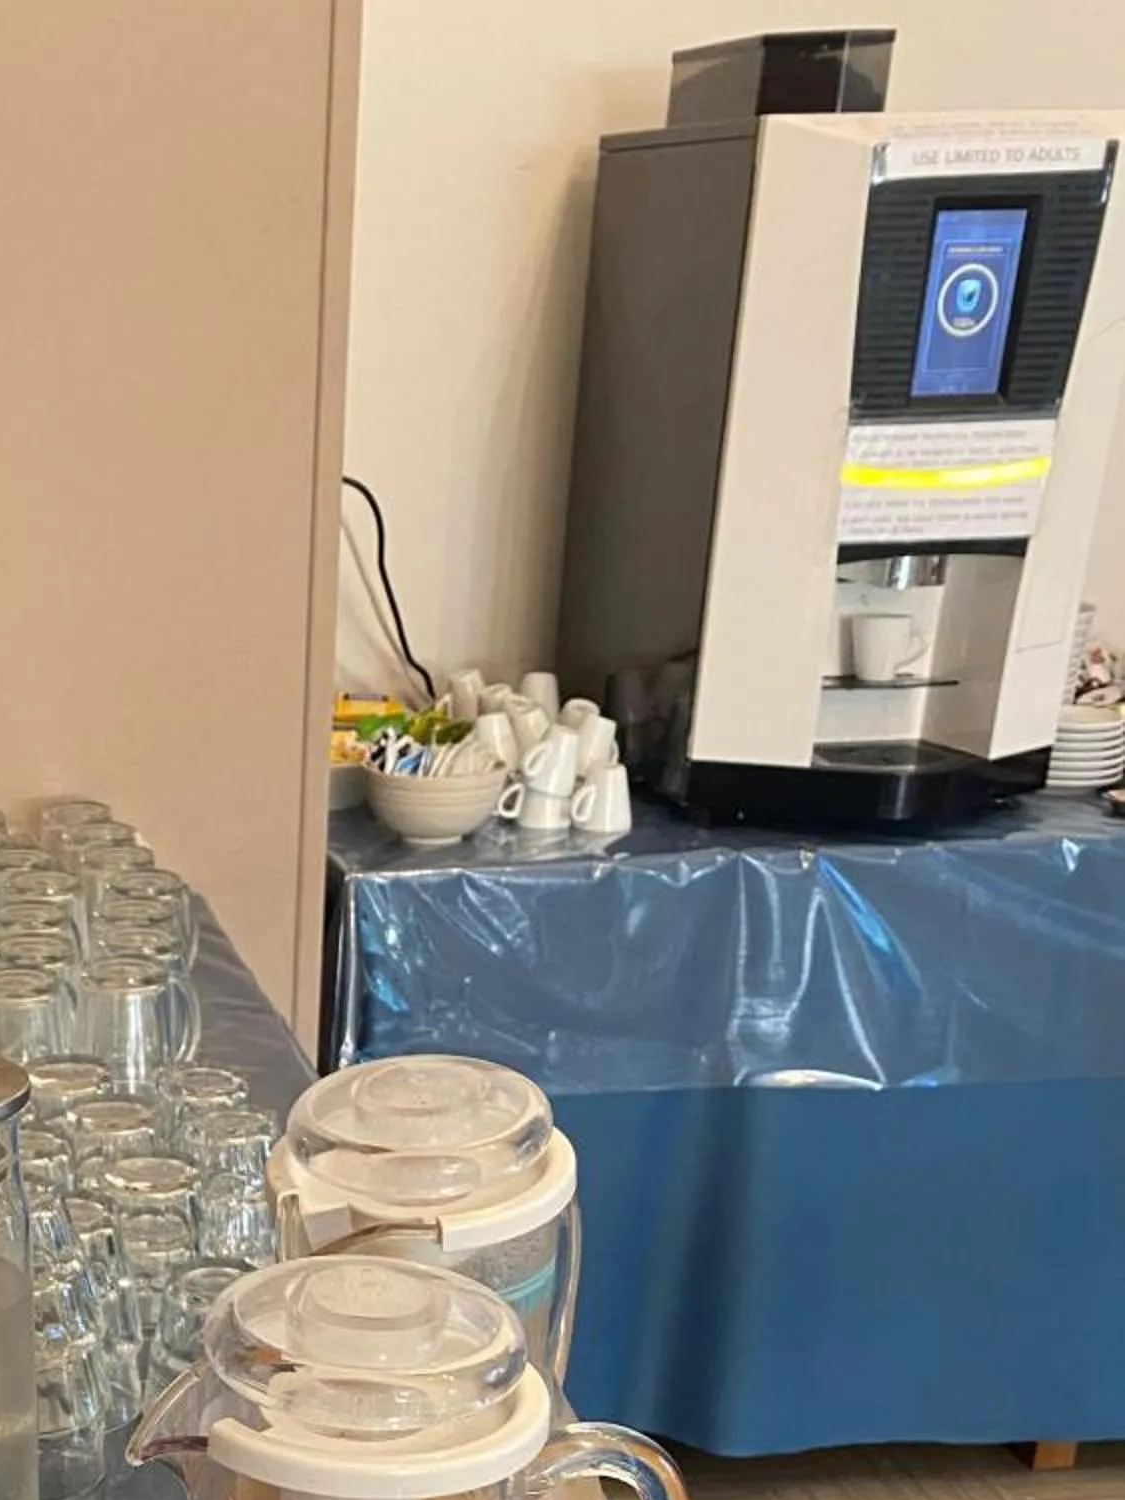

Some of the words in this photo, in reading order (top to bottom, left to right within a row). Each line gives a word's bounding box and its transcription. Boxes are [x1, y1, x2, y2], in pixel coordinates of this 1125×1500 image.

[911, 150, 938, 166] USE
[945, 148, 1001, 165] LIMITED
[1006, 148, 1025, 163] TO
[1028, 146, 1082, 162] ADULTS
